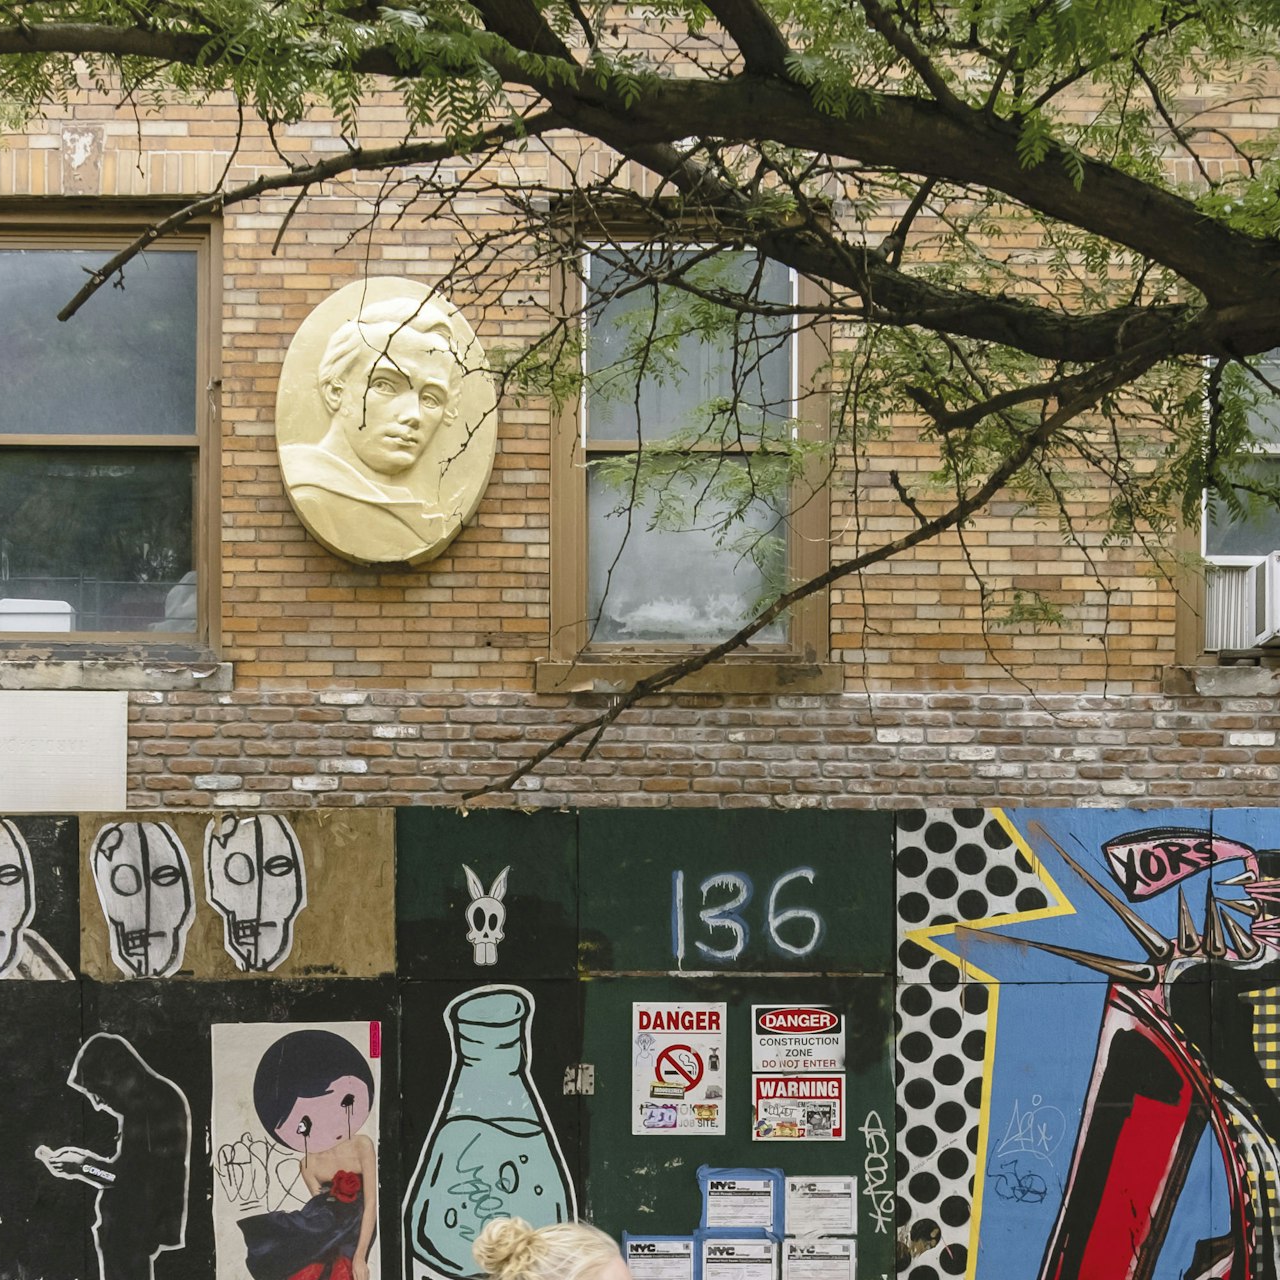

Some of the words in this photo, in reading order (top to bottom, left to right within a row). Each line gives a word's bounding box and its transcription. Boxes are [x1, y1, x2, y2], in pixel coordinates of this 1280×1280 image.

[672, 866, 826, 964] 136
[639, 1011, 721, 1031] DANGER
[765, 1014, 831, 1028] DANGER
[759, 1037, 839, 1047] CONSTRUCTION
[785, 1049, 813, 1057] ZONE
[762, 1060, 776, 1068] DO
[780, 1060, 800, 1069] NOT
[803, 1059, 836, 1068] ENTER
[759, 1081, 839, 1098] WARNING
[710, 1181, 736, 1190] NYC
[630, 1243, 656, 1252] NYC
[708, 1246, 735, 1256] NYC
